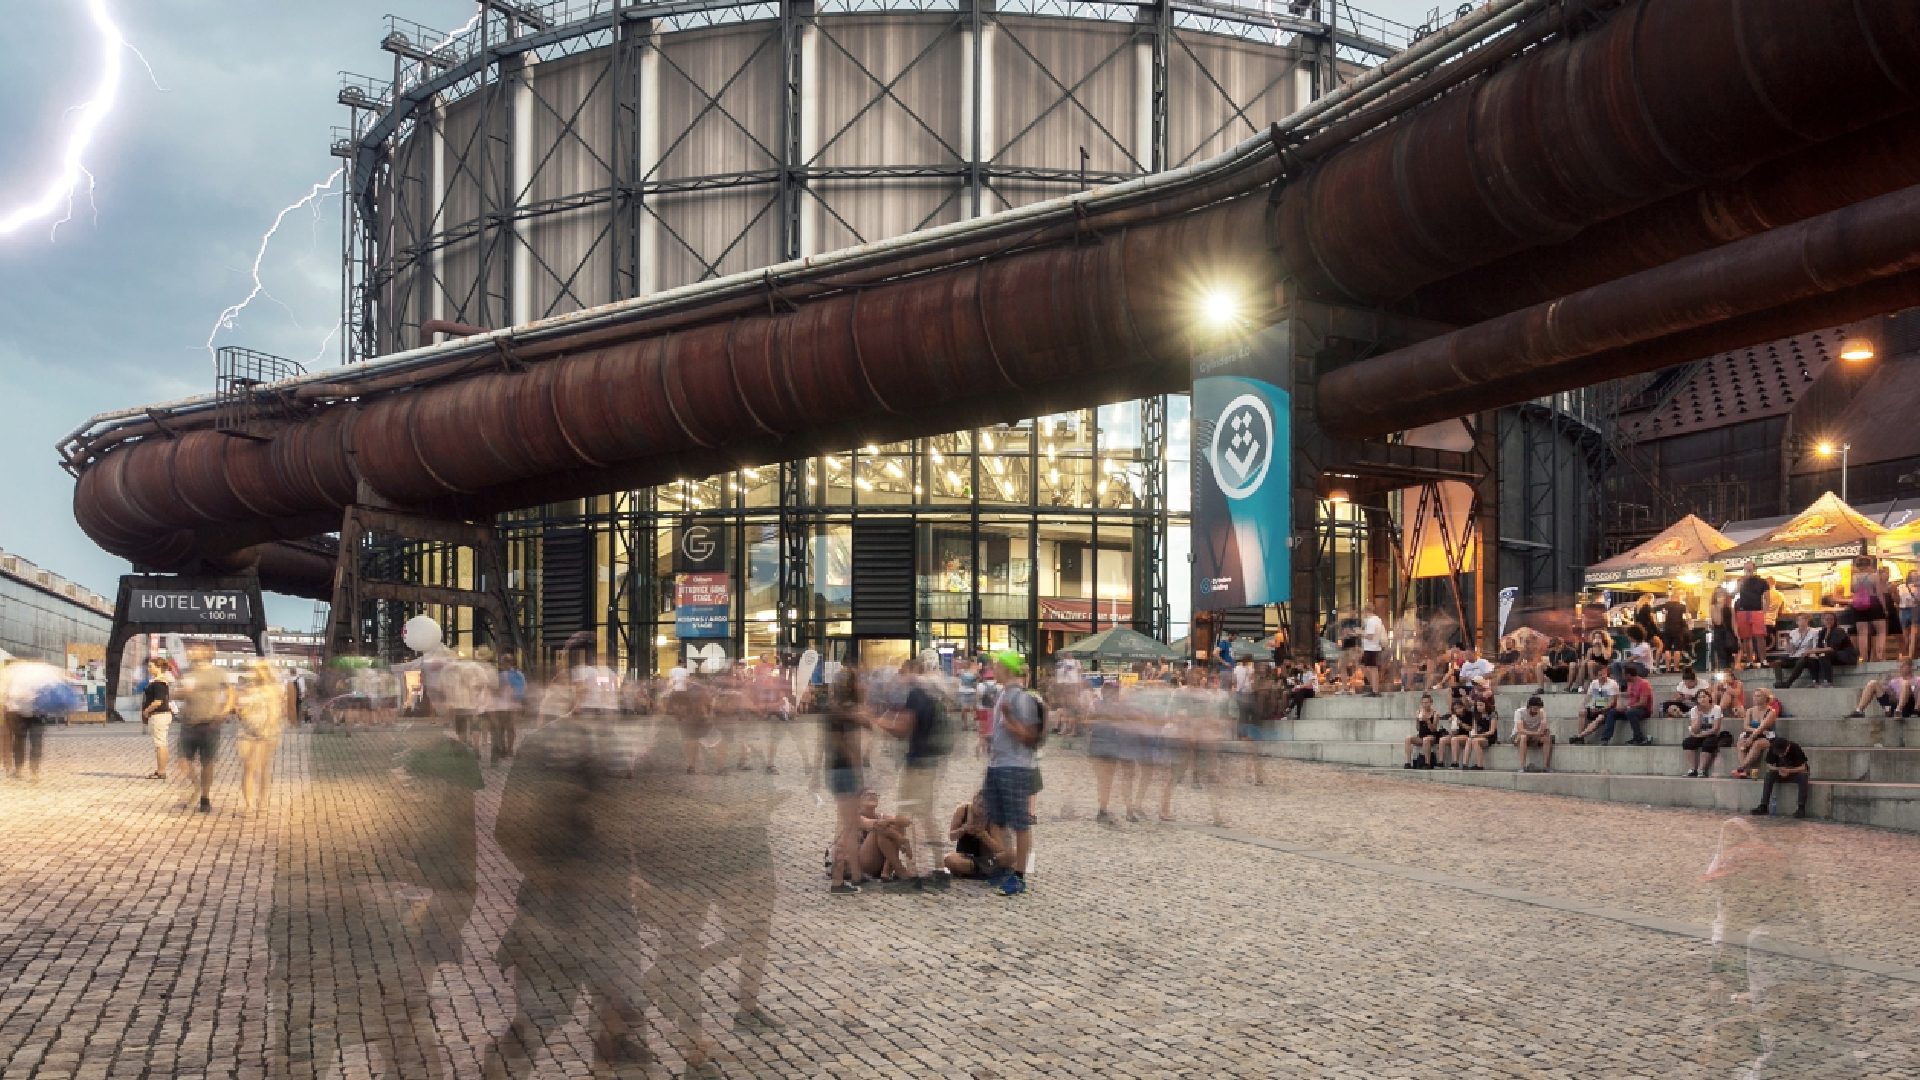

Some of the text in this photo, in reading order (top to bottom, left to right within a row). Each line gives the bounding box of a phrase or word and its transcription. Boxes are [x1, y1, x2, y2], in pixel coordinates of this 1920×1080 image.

[141, 594, 237, 610] HOTEL VP1
[209, 610, 225, 620] 100
